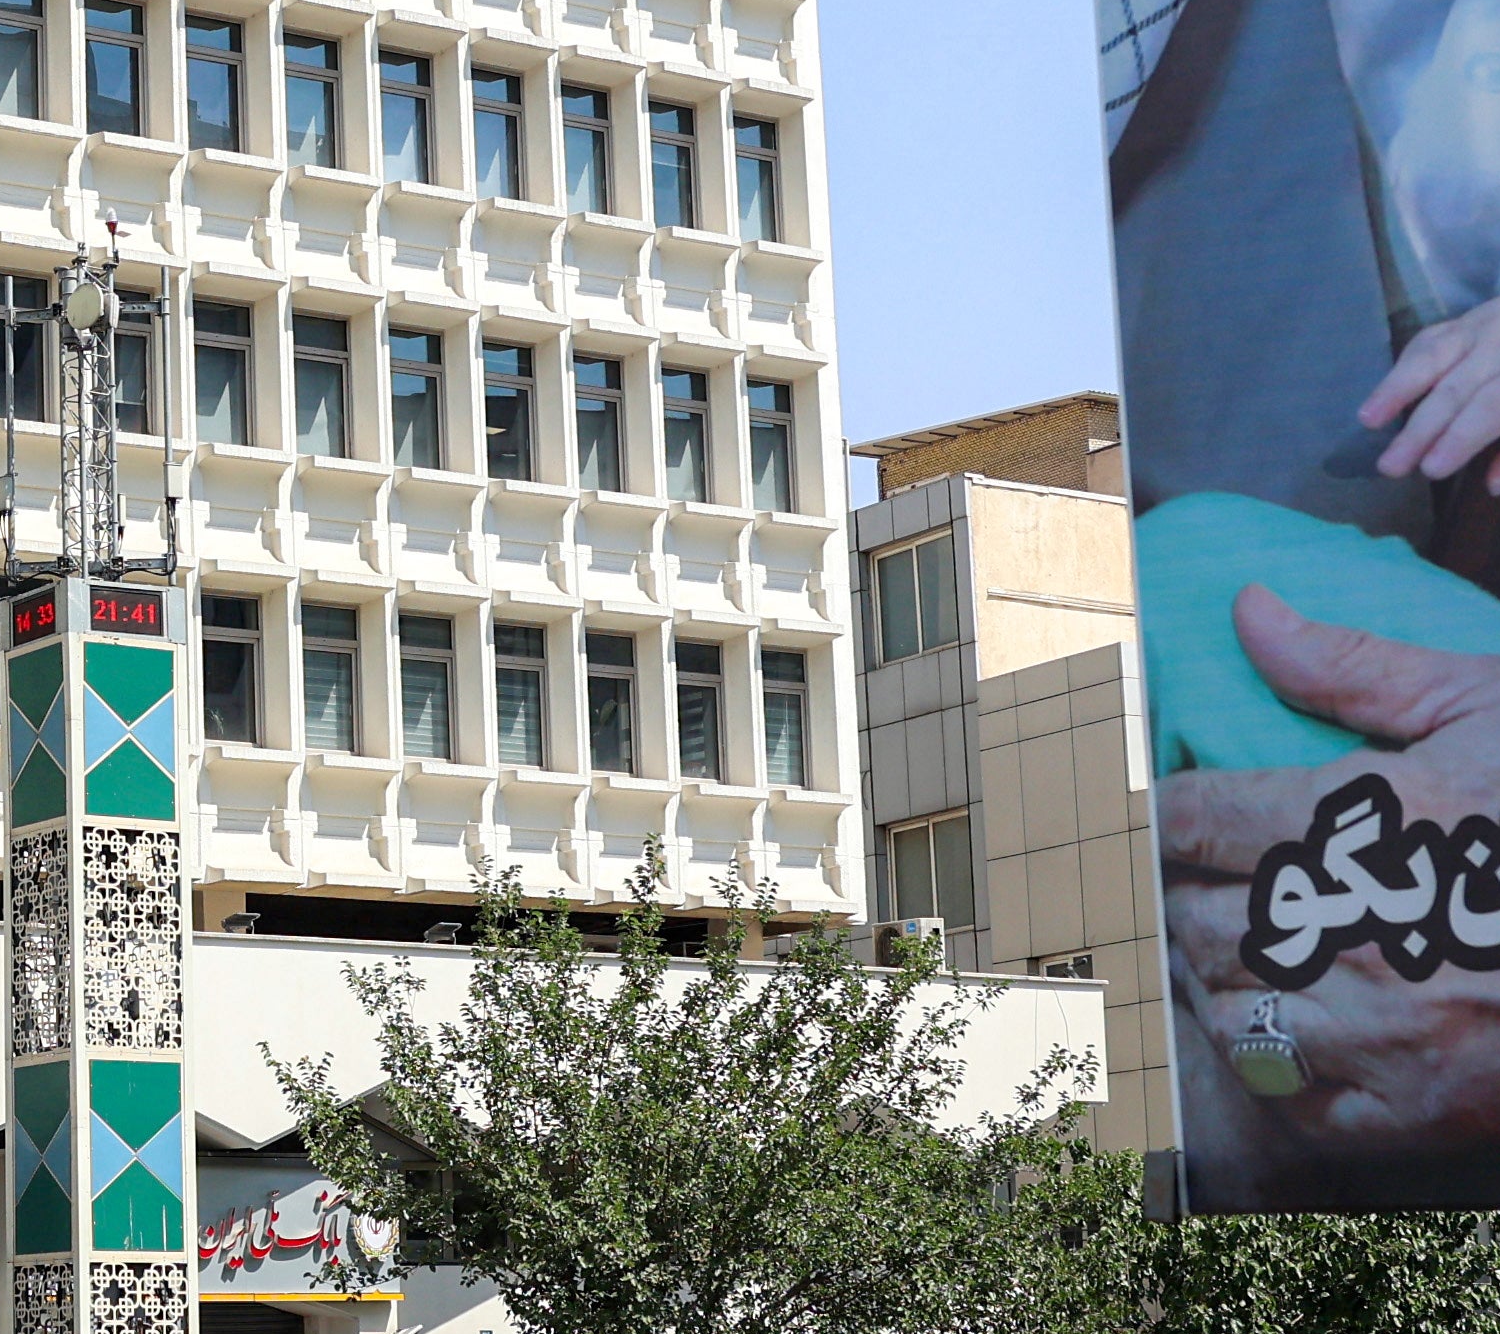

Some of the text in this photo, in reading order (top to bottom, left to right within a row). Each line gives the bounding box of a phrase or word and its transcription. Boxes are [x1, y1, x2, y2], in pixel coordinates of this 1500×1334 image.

[93, 599, 157, 624] 21:41
[1261, 798, 1436, 969] بگو
[198, 1206, 253, 1269] ایران
[276, 1190, 352, 1266] بانک
